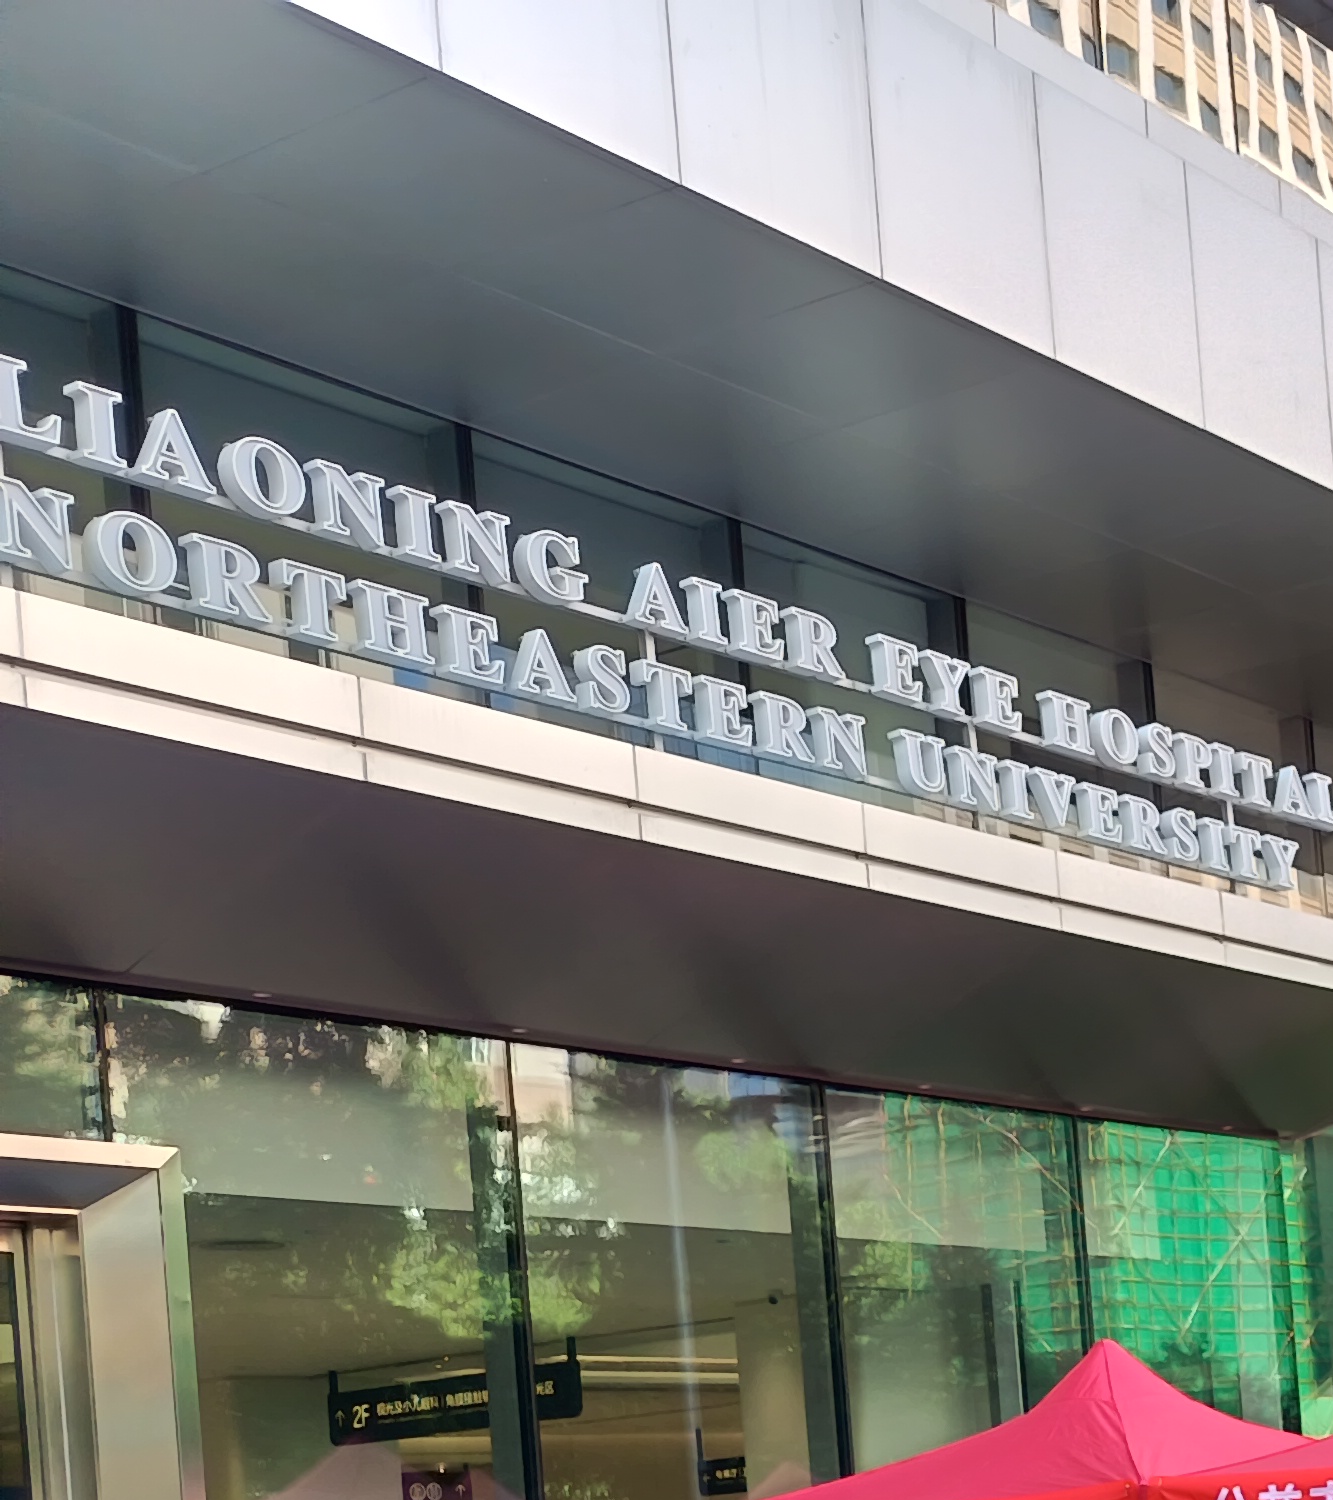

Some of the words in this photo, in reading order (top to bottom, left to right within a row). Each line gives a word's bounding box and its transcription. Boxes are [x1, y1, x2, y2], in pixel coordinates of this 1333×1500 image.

[0, 354, 589, 602] LIAONING
[624, 562, 844, 682] AIER
[865, 632, 1023, 733] EYE
[0, 476, 868, 781] NORTHEASTERN
[888, 728, 1300, 892] UNIVERSITY
[352, 1403, 371, 1429] 2F
